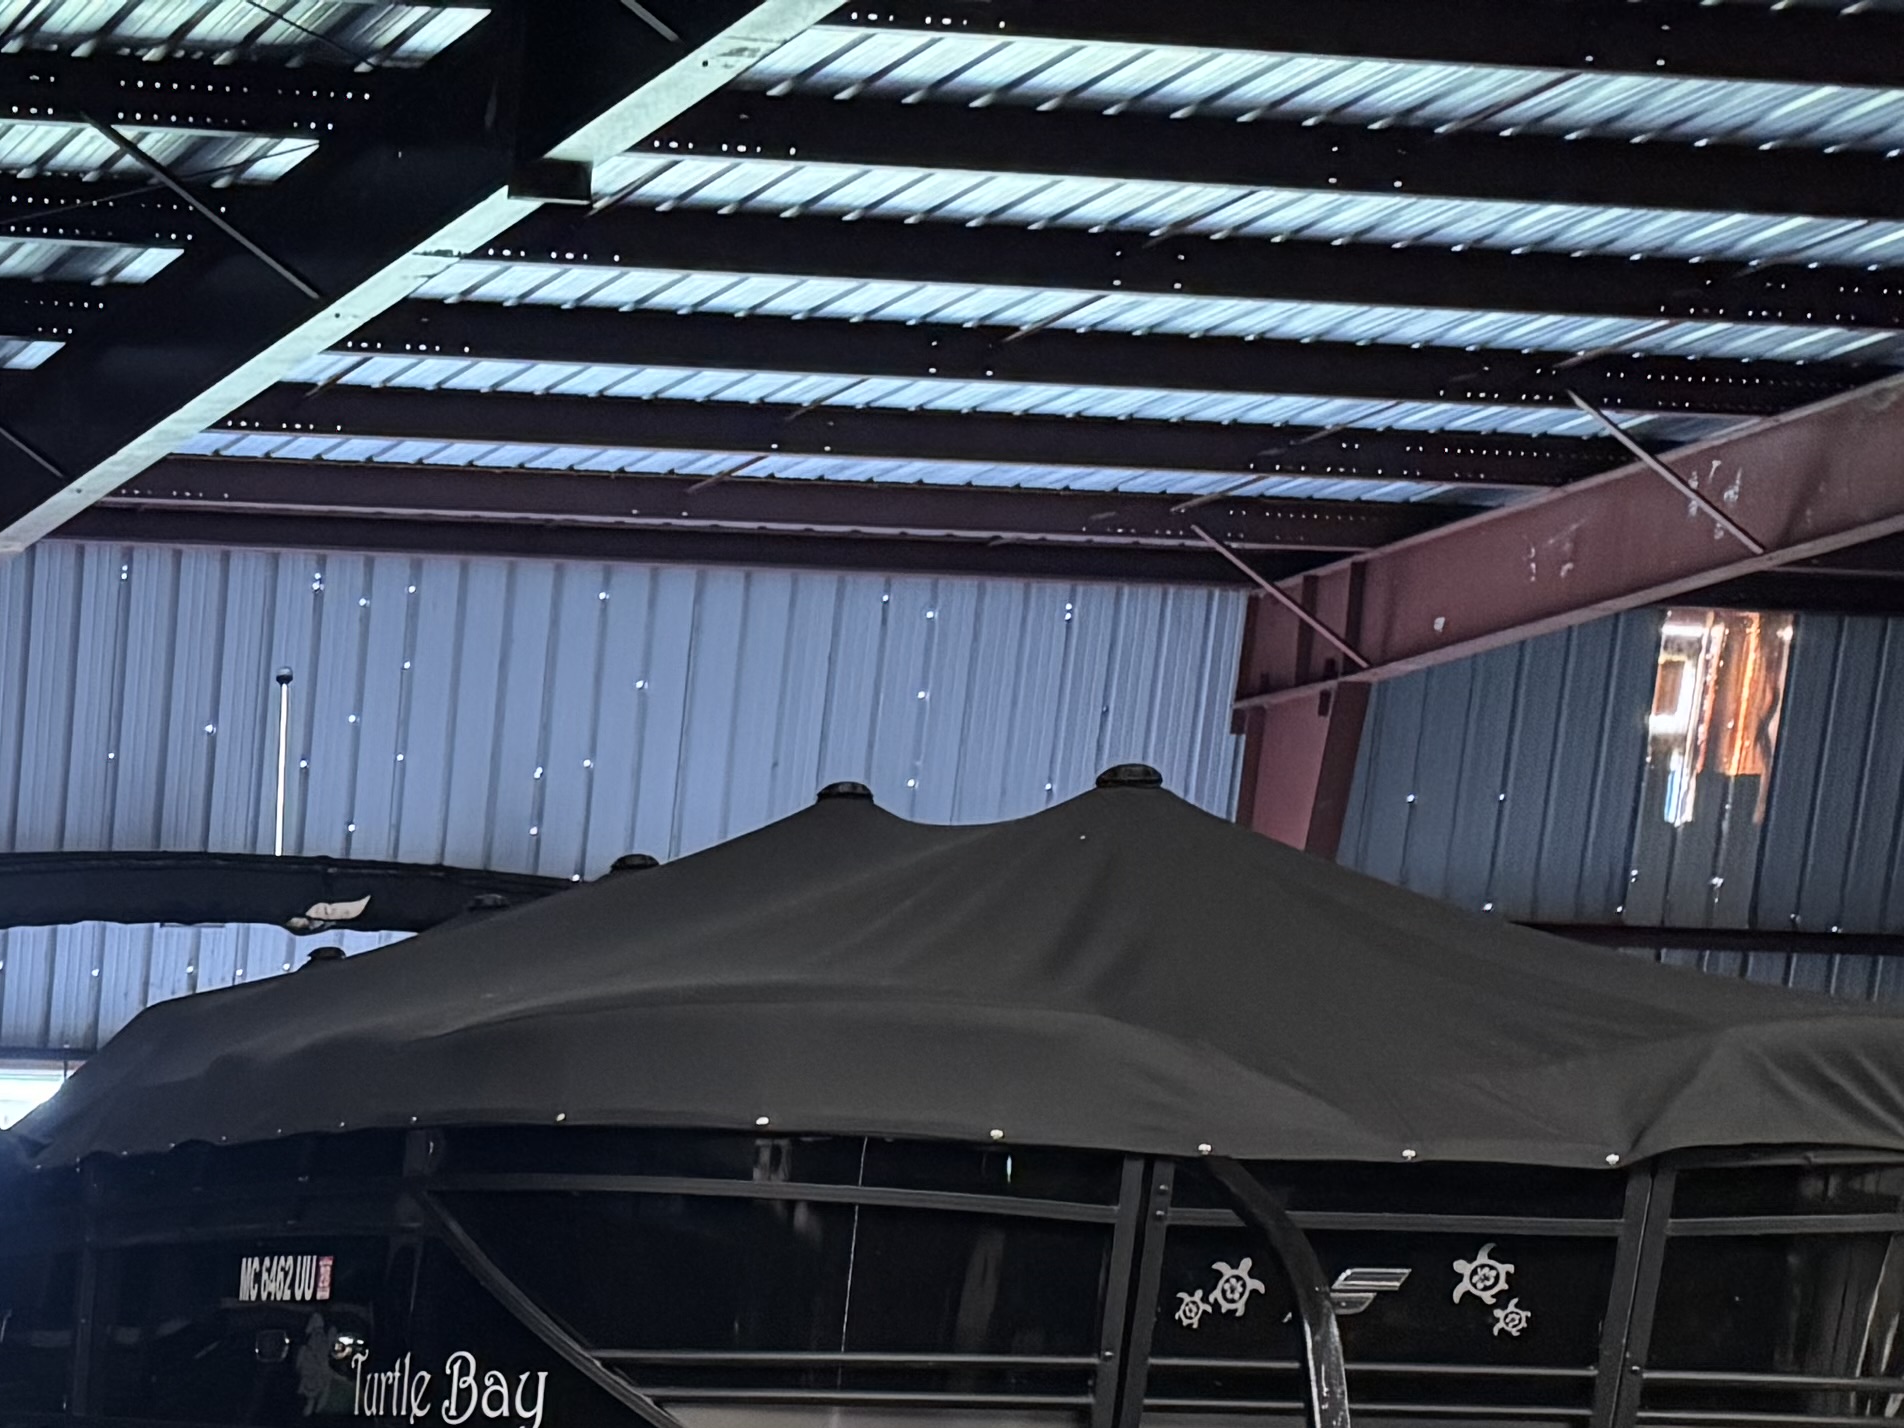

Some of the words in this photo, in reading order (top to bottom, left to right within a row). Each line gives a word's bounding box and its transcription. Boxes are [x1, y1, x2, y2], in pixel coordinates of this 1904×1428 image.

[239, 1256, 260, 1301] MC
[261, 1255, 294, 1301] 6462
[295, 1255, 317, 1301] UU
[351, 1349, 432, 1425] Turtle
